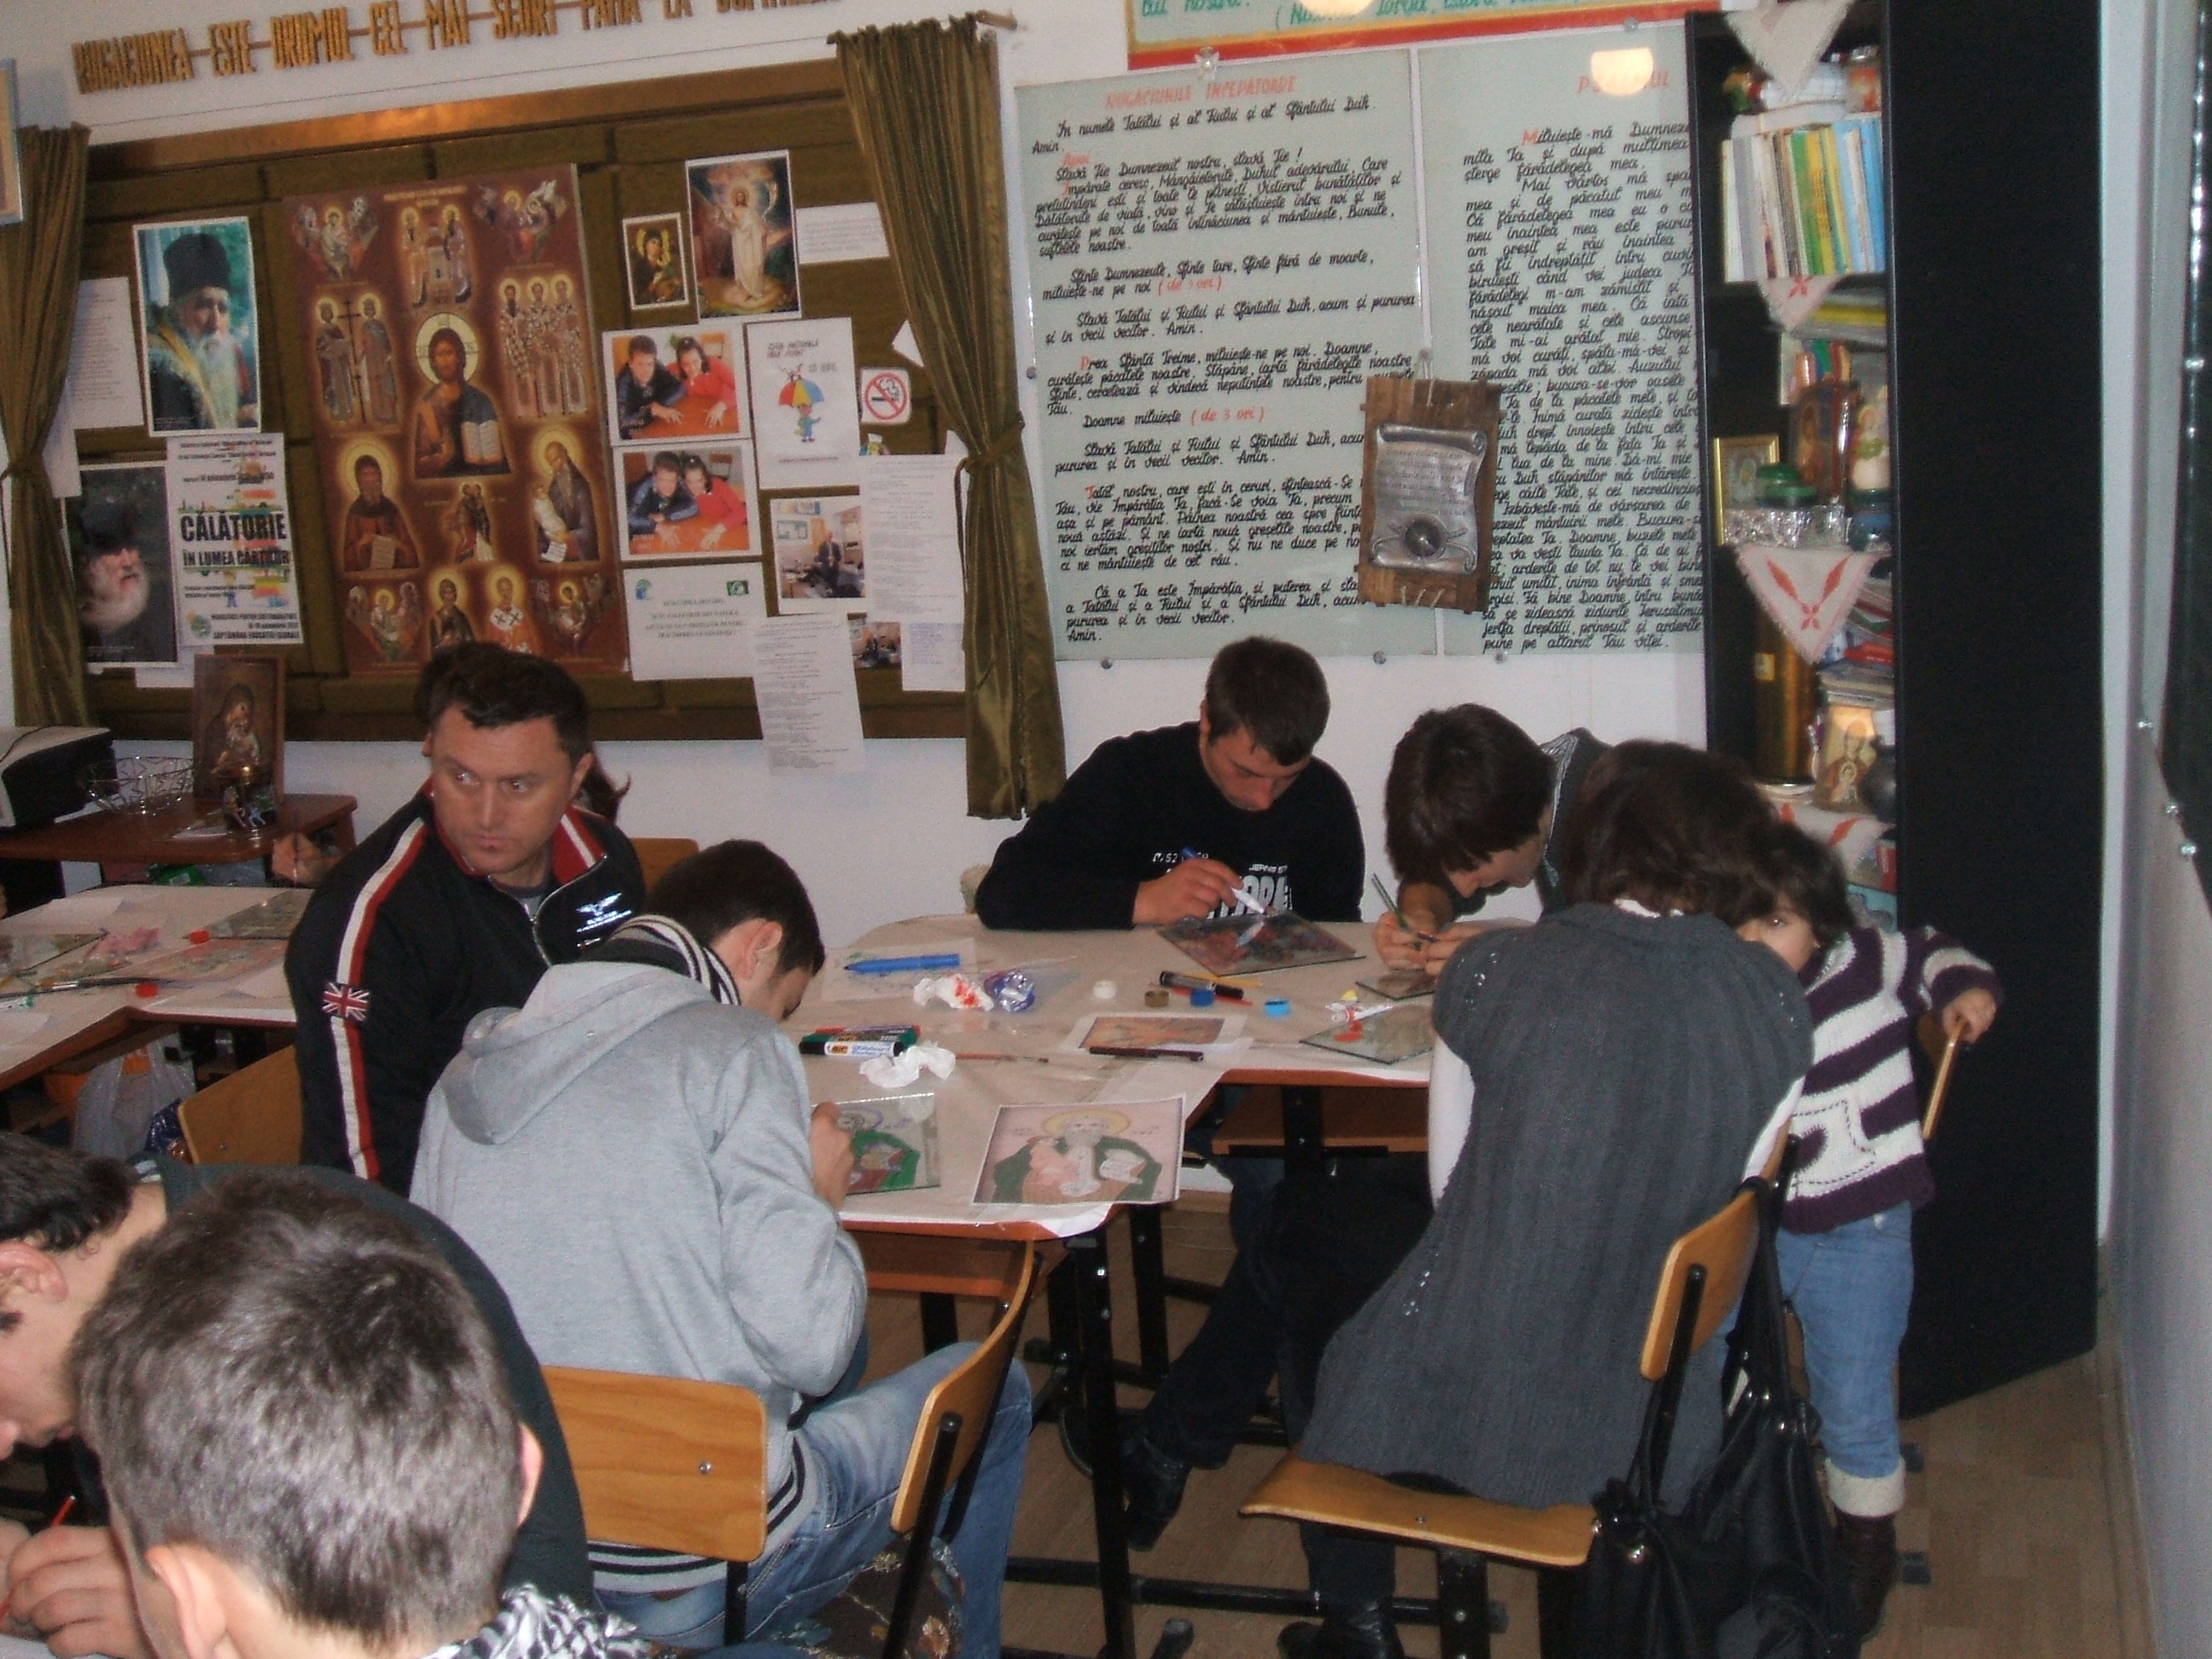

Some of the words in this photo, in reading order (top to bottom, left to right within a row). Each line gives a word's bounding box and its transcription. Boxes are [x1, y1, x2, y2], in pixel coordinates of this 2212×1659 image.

[208, 19, 256, 78] ESTE
[270, 7, 355, 70] DRUMUL
[370, 0, 407, 56] CEL
[427, 0, 472, 50] MAI
[181, 509, 286, 541] CĂLĂTORIE
[199, 550, 235, 566] LUMEA
[830, 1045, 848, 1054] BIC
